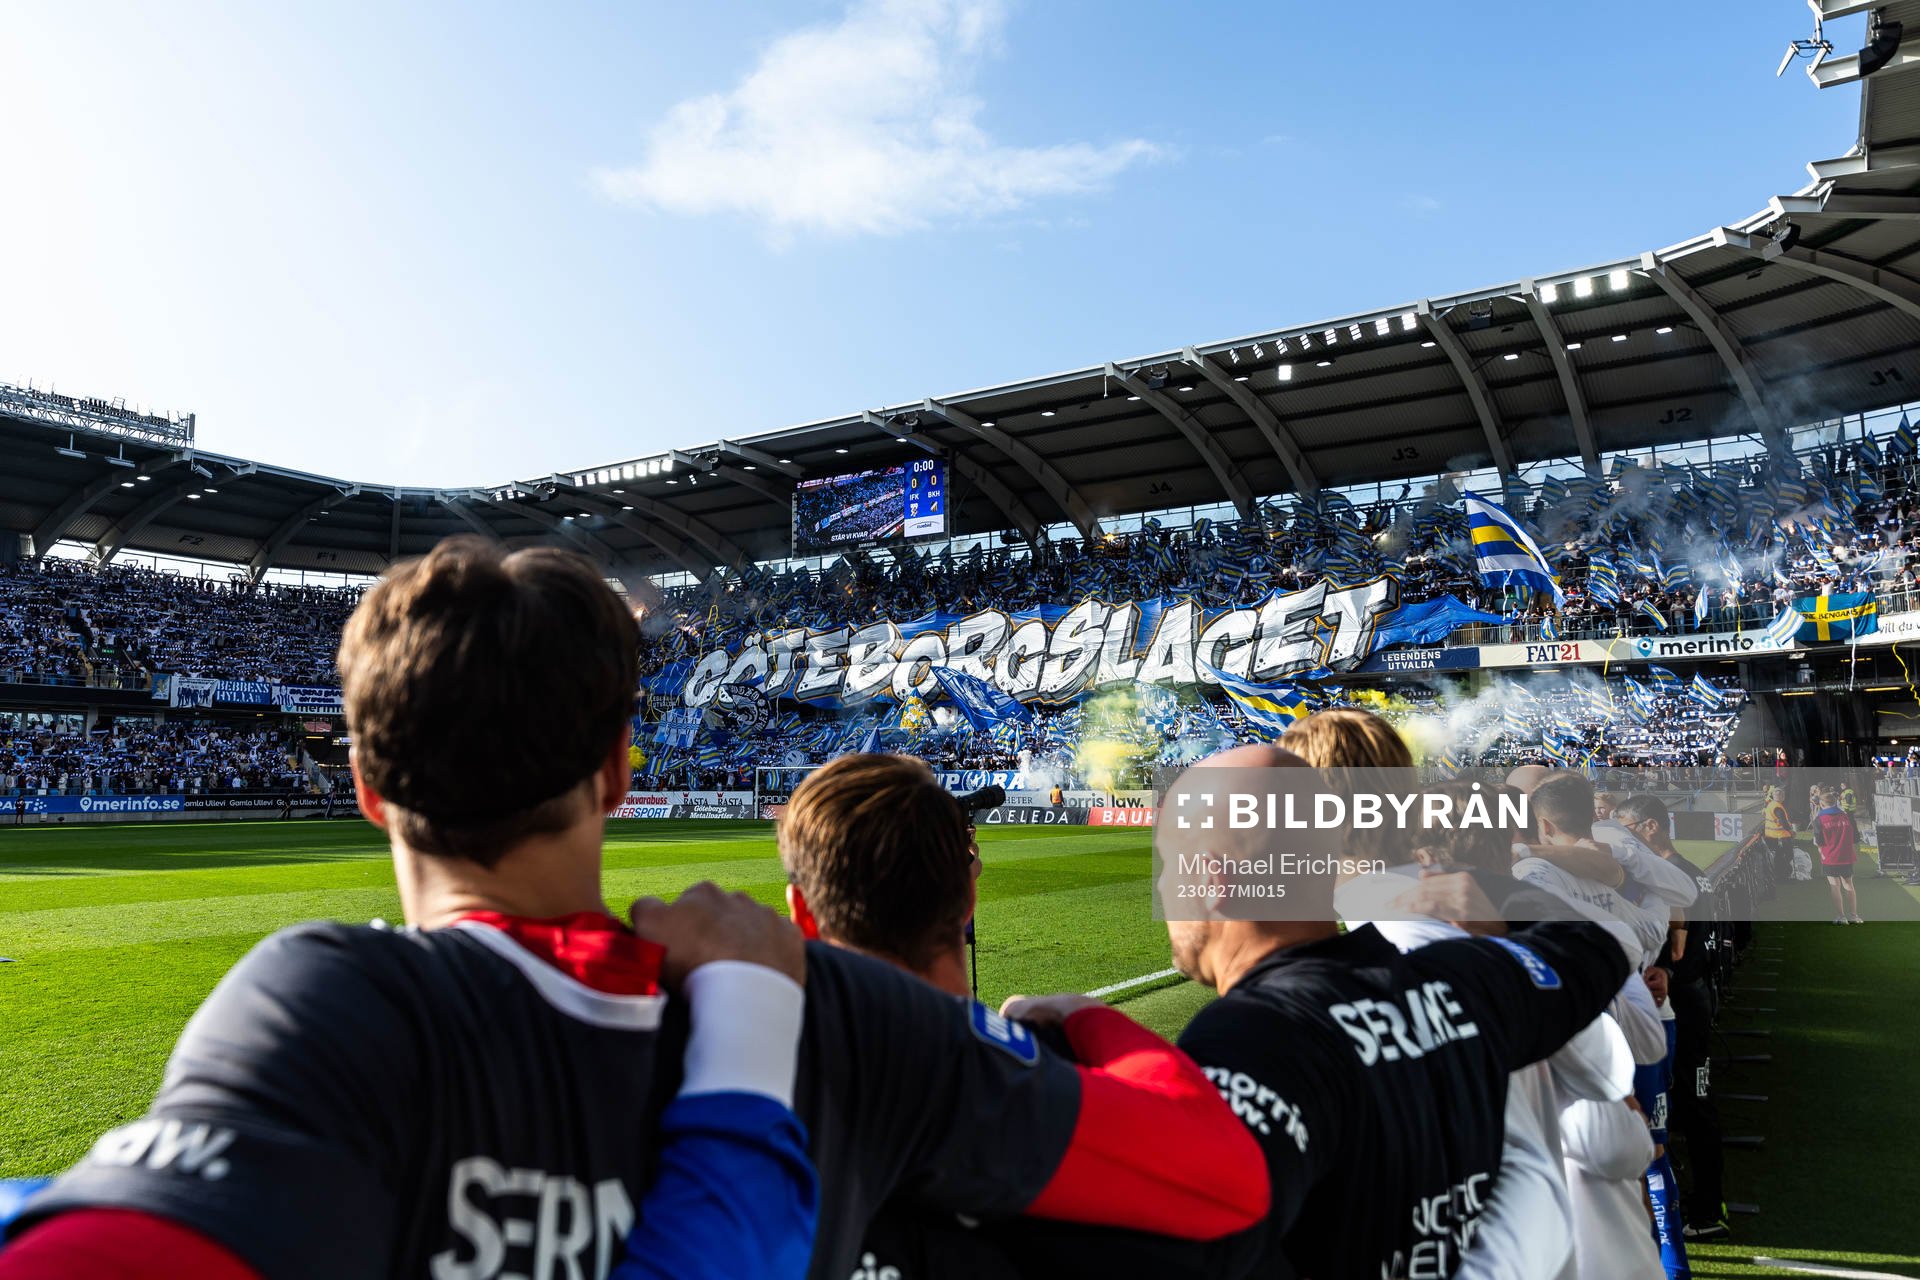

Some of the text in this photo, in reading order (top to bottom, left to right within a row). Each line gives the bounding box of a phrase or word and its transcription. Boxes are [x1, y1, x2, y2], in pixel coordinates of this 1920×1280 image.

[1869, 367, 1905, 386] J1
[1658, 407, 1693, 425] J2
[1391, 446, 1420, 461] J3
[913, 459, 934, 473] 0:00
[911, 475, 937, 489] 0 0
[909, 490, 941, 501] IFK BKH
[178, 534, 205, 546] F2
[831, 533, 846, 541] STÅR
[852, 530, 869, 538] KVAR
[1898, 621, 1913, 632] du
[1660, 635, 1774, 656] merinfo.s
[1381, 651, 1441, 663] LEGENDENS
[1526, 643, 1582, 663] FAT21
[1387, 660, 1435, 670] UTVALDA
[93, 796, 180, 810] merinfo.se
[229, 799, 273, 807] Gamla Ullevi
[683, 798, 743, 806] RASTA RASTA
[1112, 794, 1144, 808] law.
[608, 807, 668, 818] NTERSPORT
[693, 804, 727, 813] Göteborgs
[689, 811, 734, 819] Metallpartier
[1007, 809, 1069, 824] ELEDA
